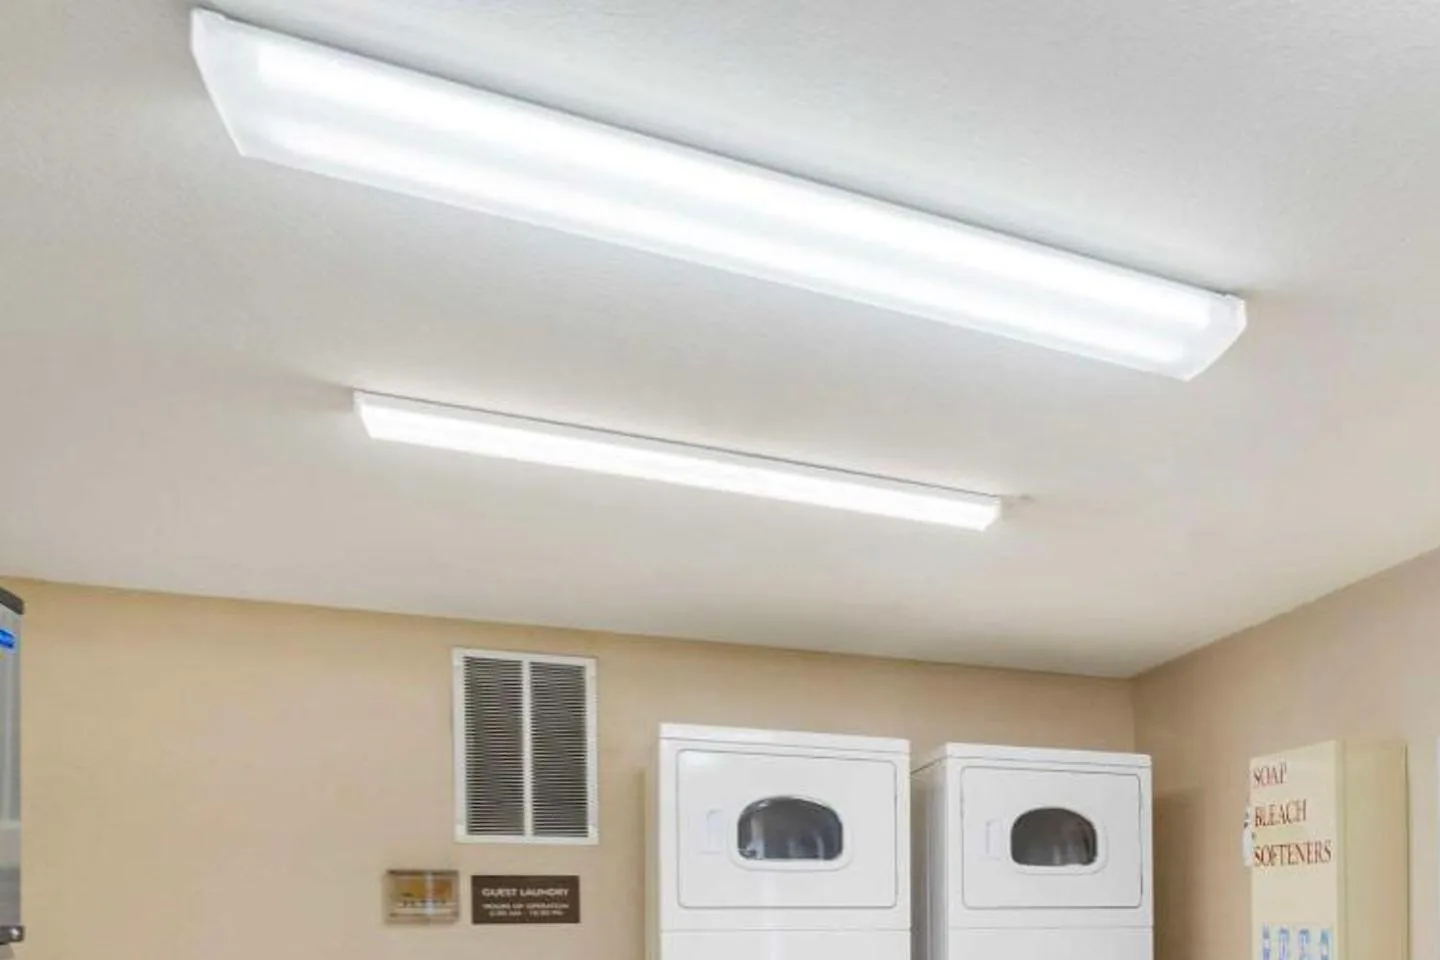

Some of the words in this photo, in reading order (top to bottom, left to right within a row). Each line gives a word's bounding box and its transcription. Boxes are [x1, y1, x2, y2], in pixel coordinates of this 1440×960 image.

[1252, 762, 1287, 789] SOAP
[1254, 800, 1307, 828] BLEACH
[1253, 840, 1332, 868] SOFTENERS
[481, 888, 517, 897] GUEST
[519, 888, 569, 897] LAUNDRY
